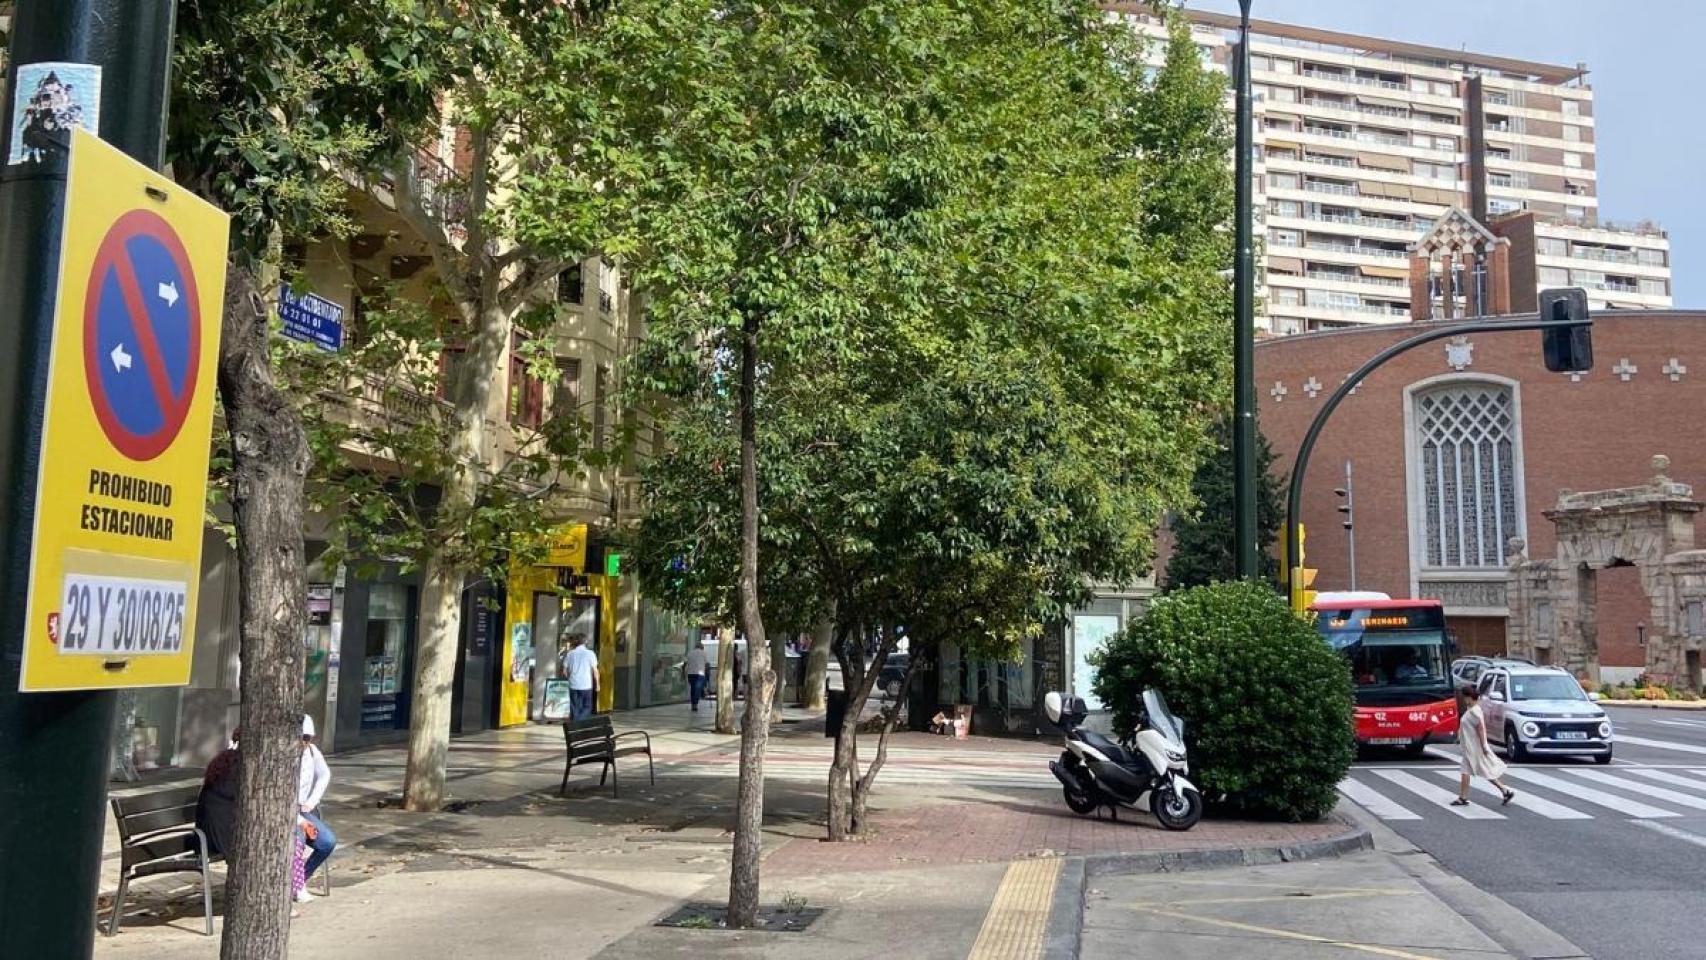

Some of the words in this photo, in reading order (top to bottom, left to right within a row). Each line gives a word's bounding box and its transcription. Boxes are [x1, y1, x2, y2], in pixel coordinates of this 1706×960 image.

[89, 469, 173, 508] PROHIBIDO
[81, 504, 173, 541] ESTACIONAR
[63, 583, 91, 649] 29
[97, 587, 112, 649] Y
[113, 588, 185, 651] 30/08/25
